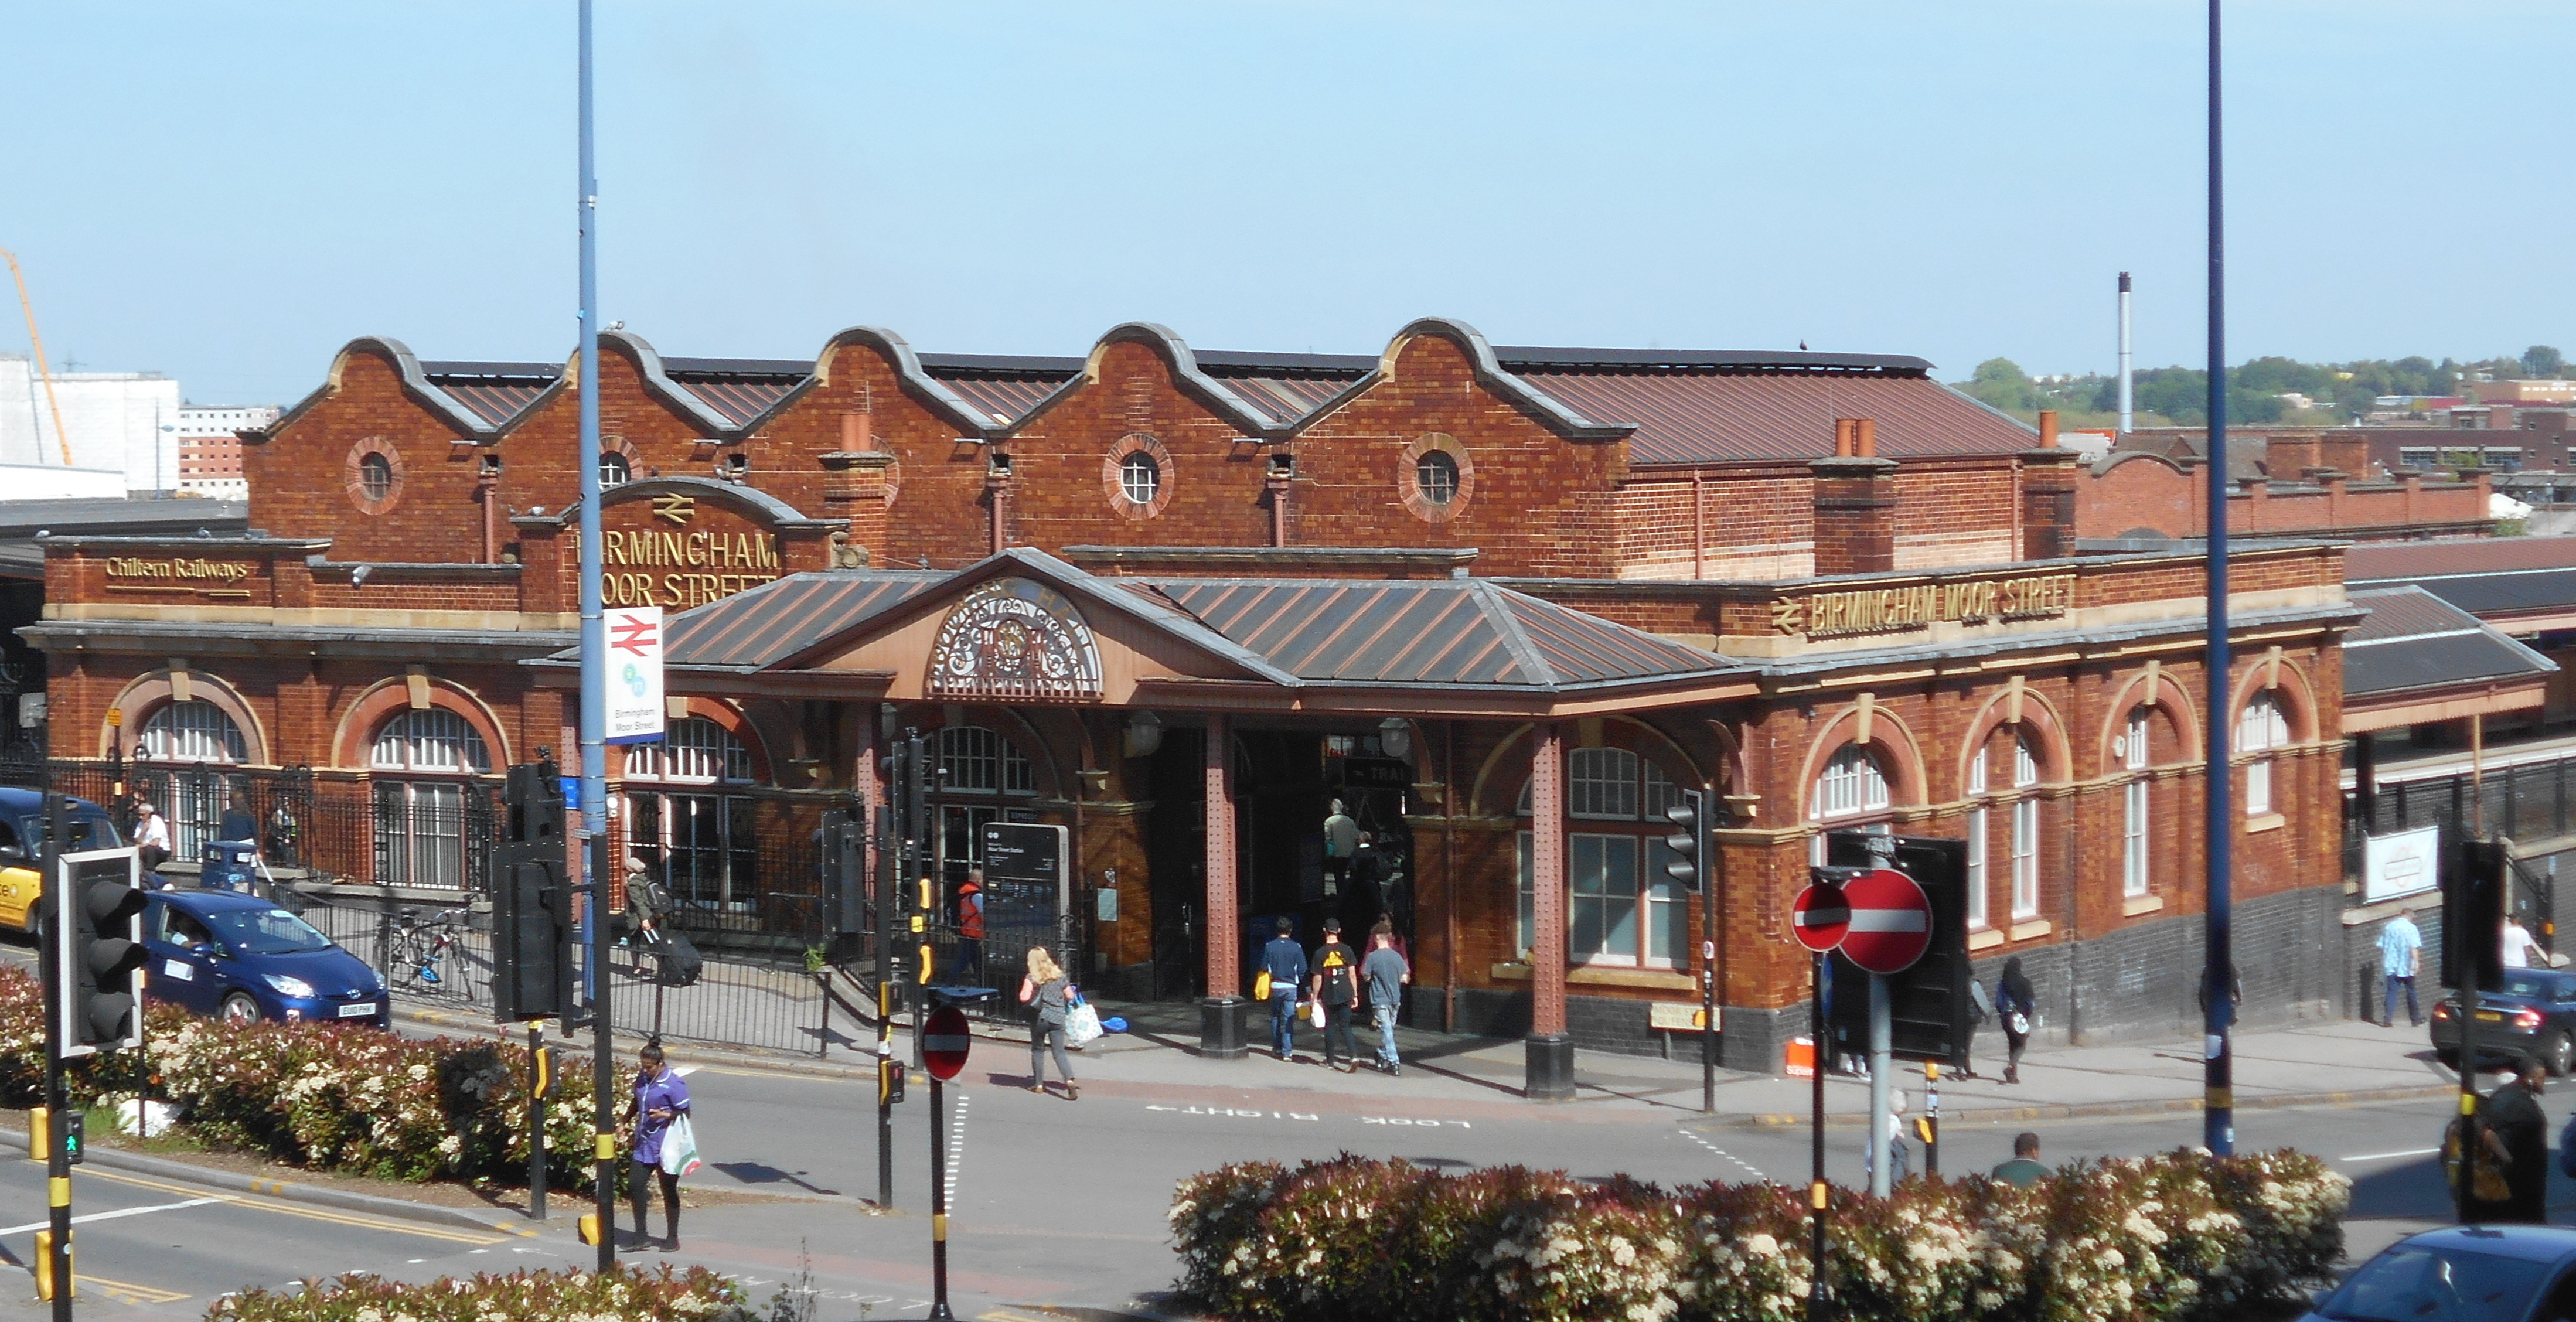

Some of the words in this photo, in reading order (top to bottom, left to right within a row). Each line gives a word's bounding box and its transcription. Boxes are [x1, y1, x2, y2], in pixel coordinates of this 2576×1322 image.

[576, 531, 778, 567] IRMINGHAM
[106, 557, 170, 577] Chiltern
[174, 558, 247, 582] Railways
[577, 573, 655, 607] OOR
[1811, 585, 1937, 632] BIRMINGHAM
[1944, 581, 1995, 621] MOOR
[2003, 574, 2077, 614] STREET
[615, 708, 655, 718] Birmingham
[616, 723, 632, 731] Moor
[635, 721, 655, 730] Street
